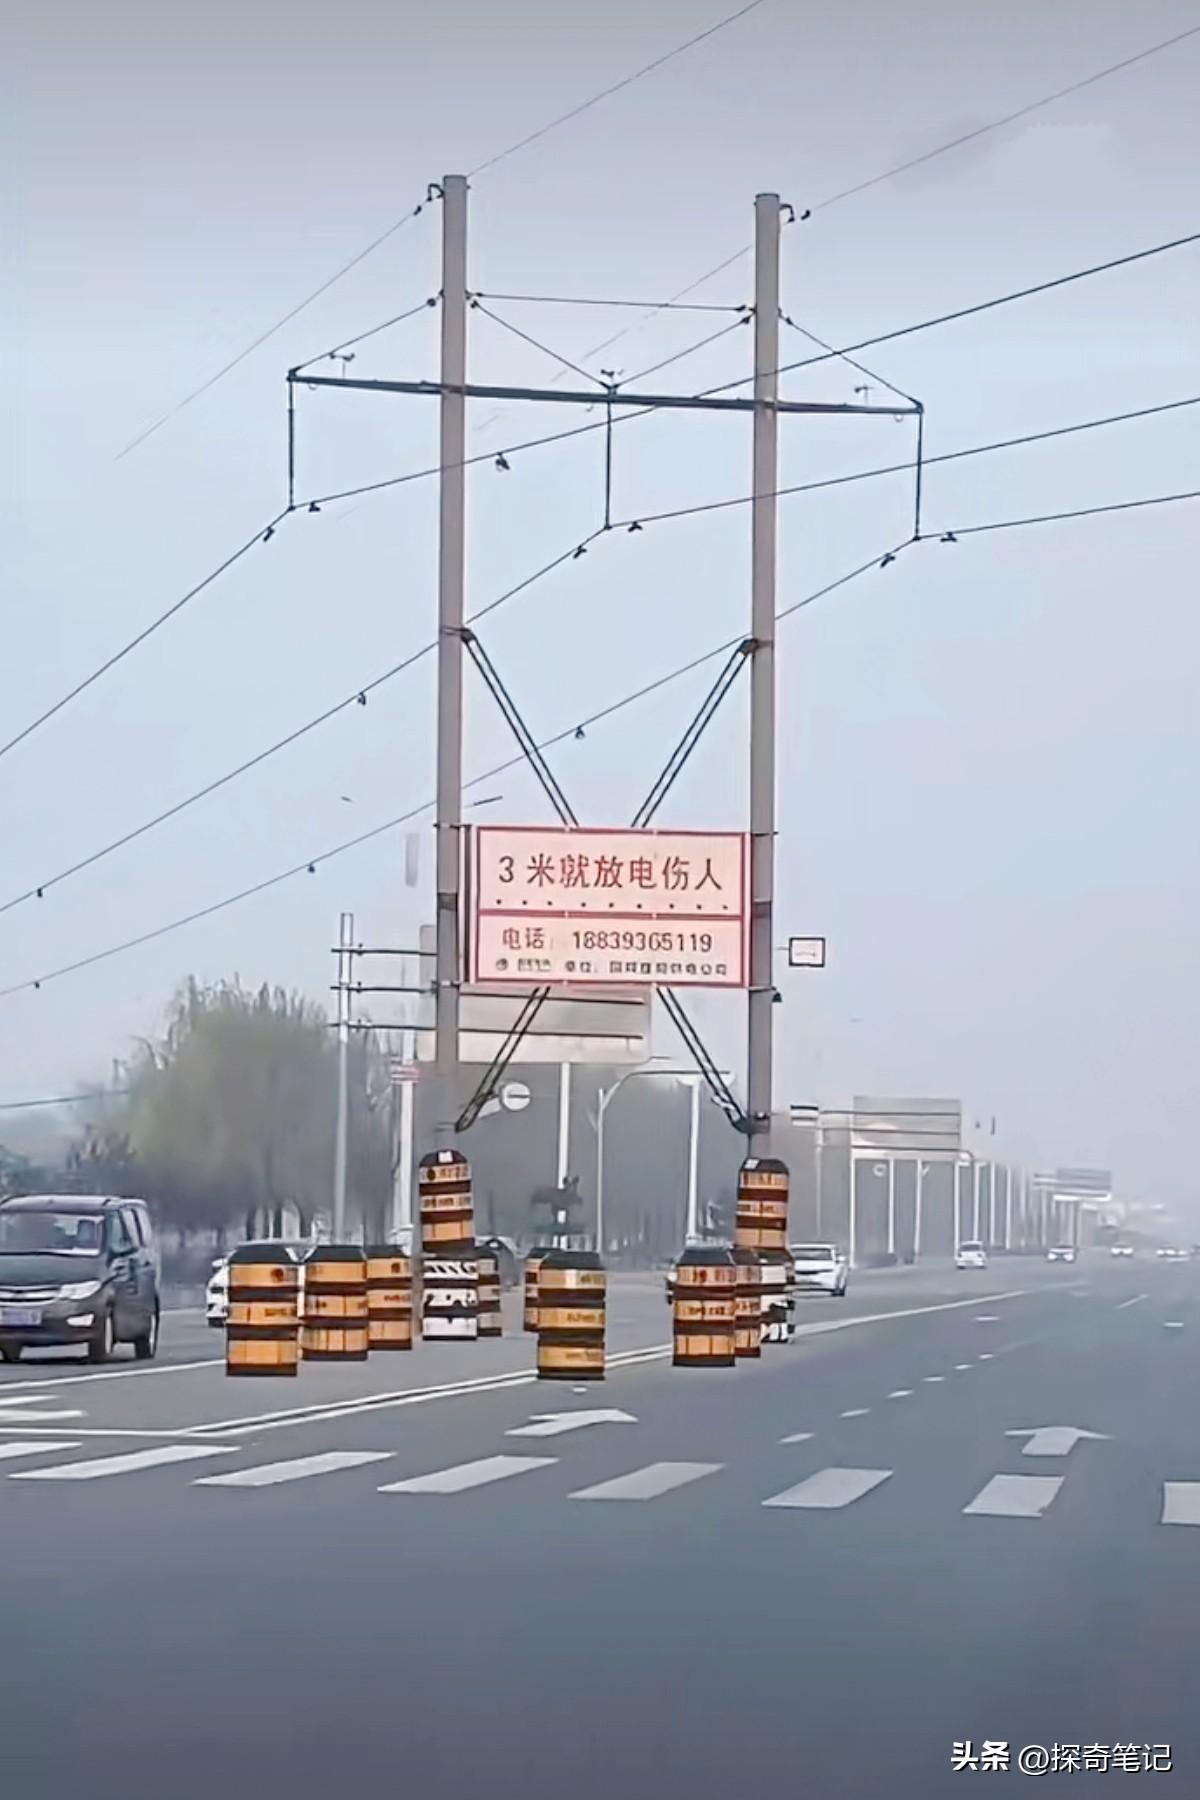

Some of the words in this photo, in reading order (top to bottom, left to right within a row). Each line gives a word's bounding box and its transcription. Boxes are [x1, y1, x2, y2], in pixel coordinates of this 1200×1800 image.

[499, 853, 722, 890] 3米就放电伤人
[573, 930, 712, 952] 18839365119
